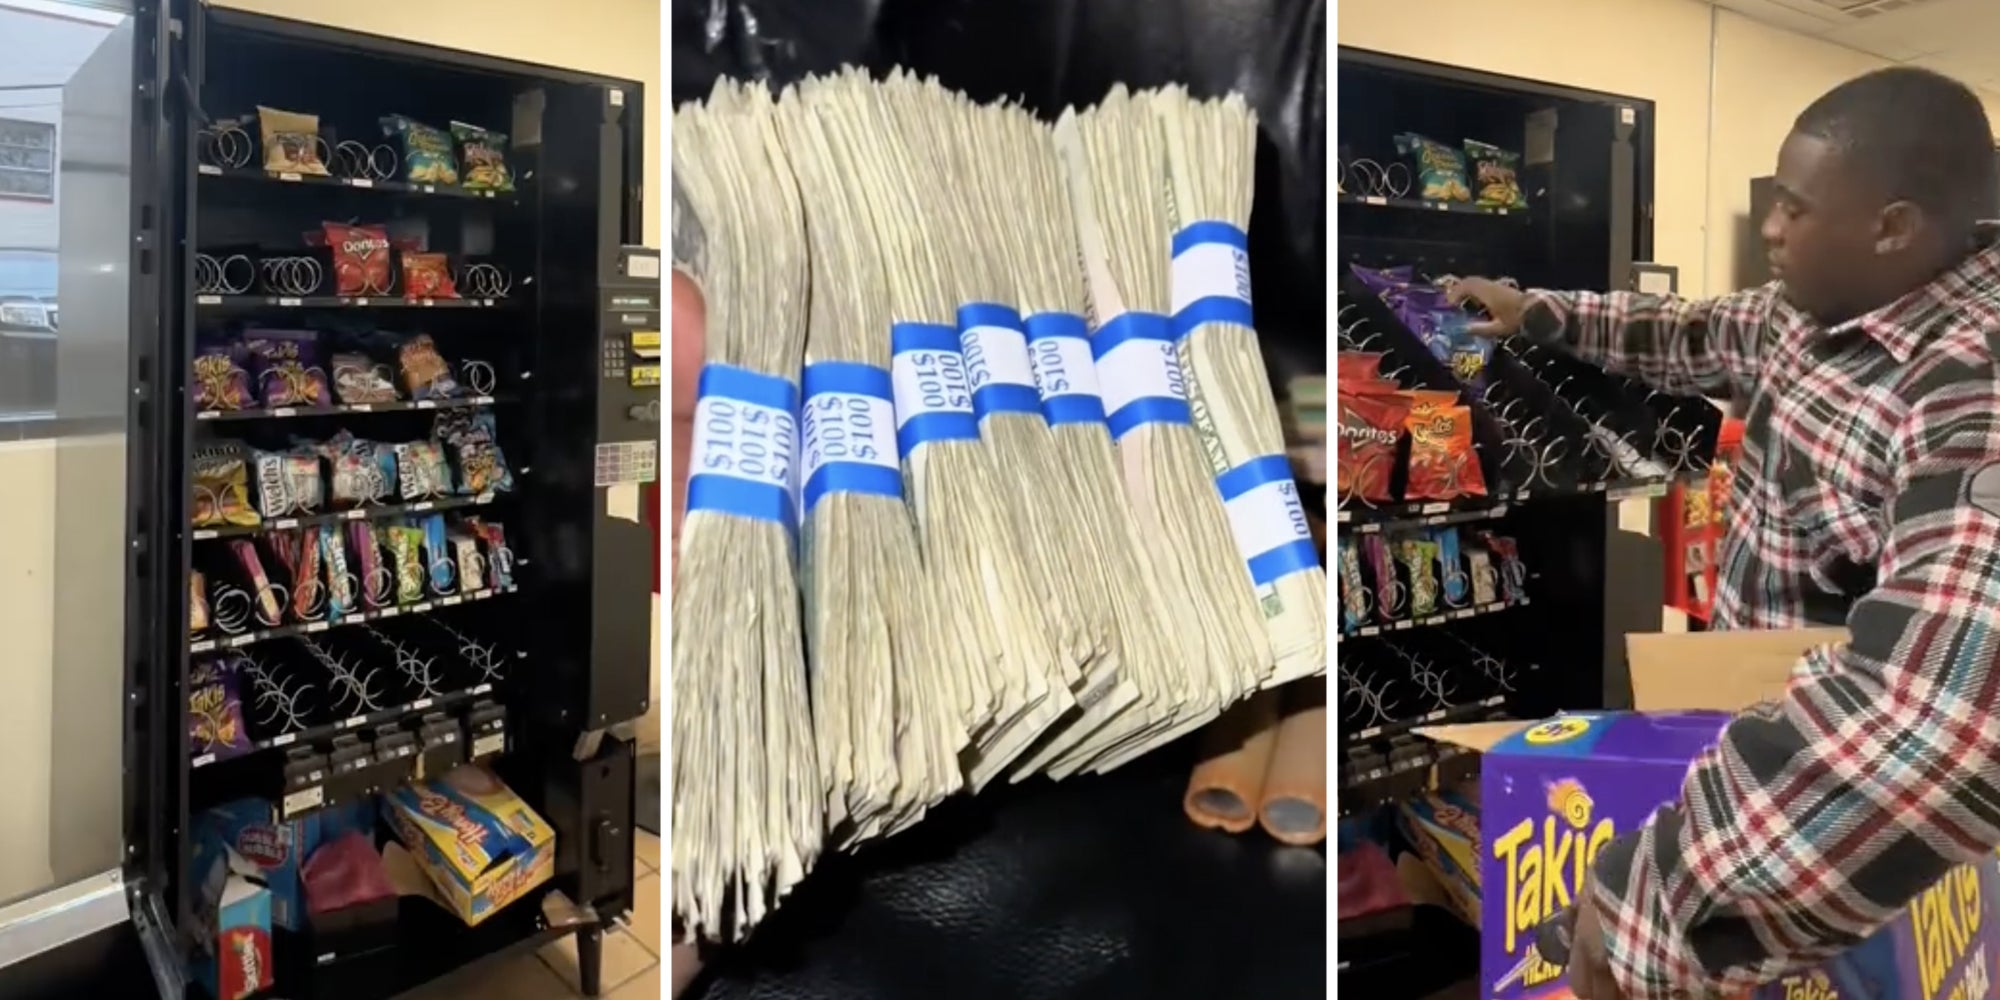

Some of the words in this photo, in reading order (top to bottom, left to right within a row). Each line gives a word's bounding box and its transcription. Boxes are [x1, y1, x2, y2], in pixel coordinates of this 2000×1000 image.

[343, 239, 390, 254] Doritos
[911, 353, 946, 408] $100
[938, 354, 972, 408] $100
[963, 332, 991, 387] $100
[1038, 340, 1070, 392] $100
[1161, 344, 1186, 396] $100
[701, 401, 736, 471] $100
[738, 406, 770, 476] $100
[770, 415, 794, 482] $100
[818, 396, 848, 457] $100
[847, 398, 878, 460] $100
[1278, 482, 1309, 536] $100
[1911, 863, 1981, 1000] Takis
